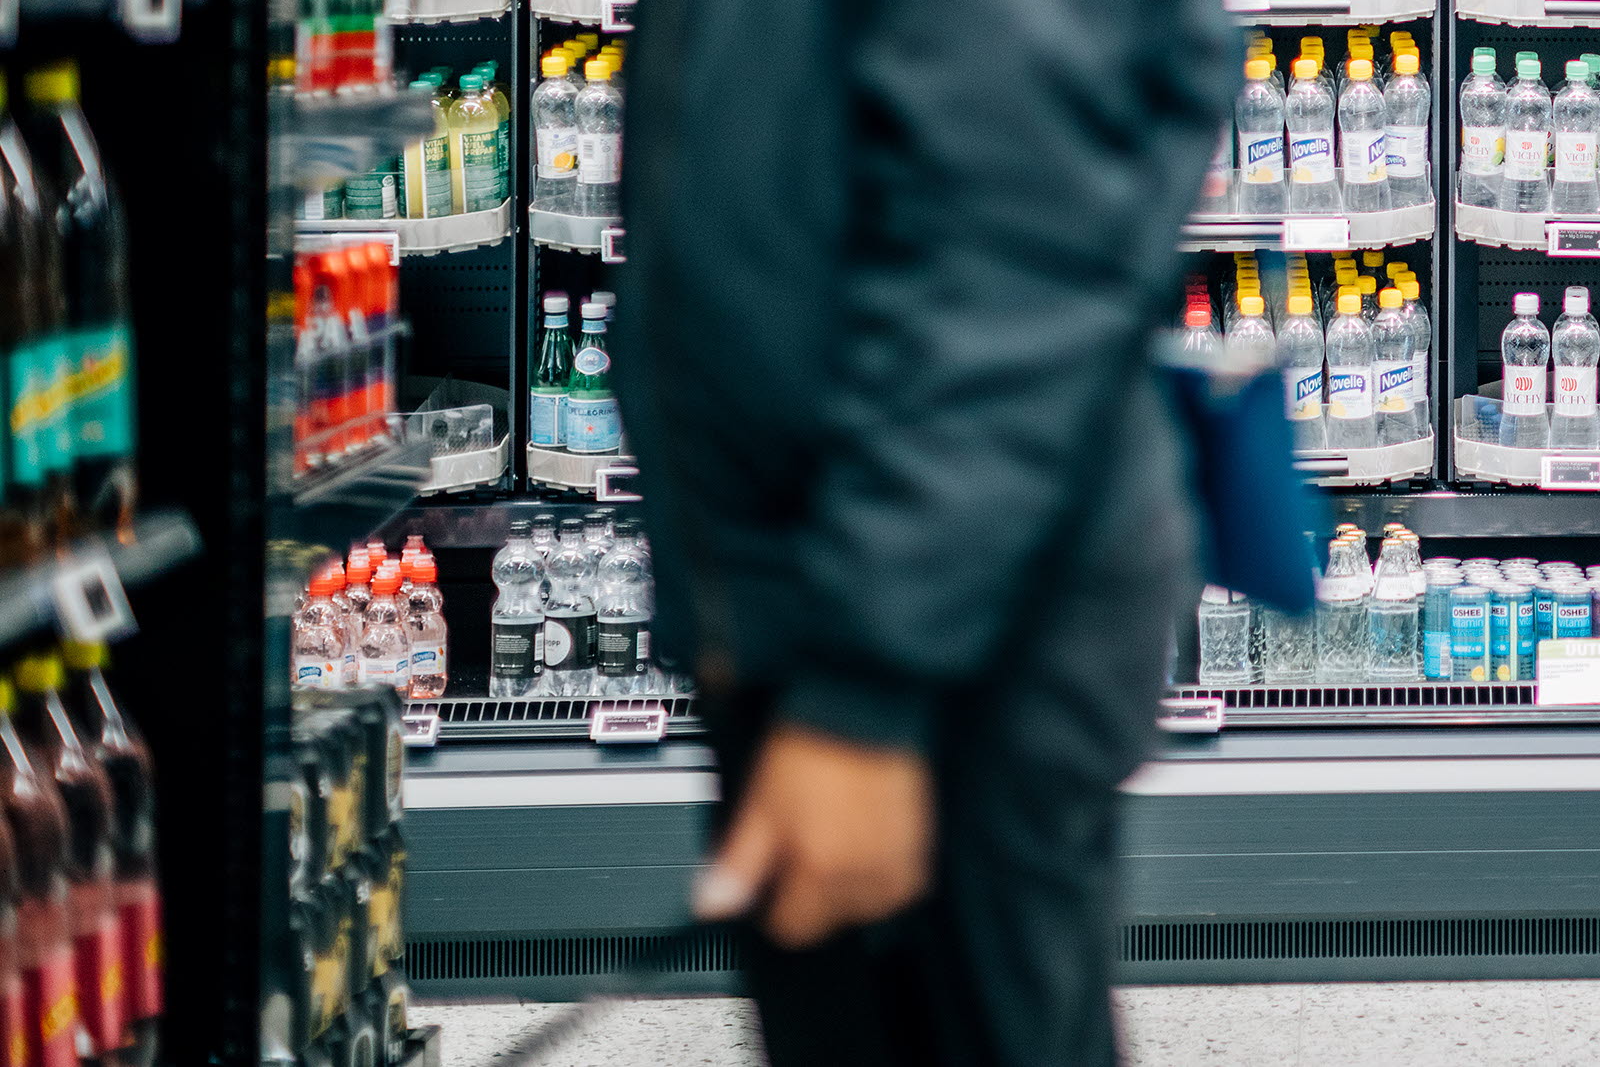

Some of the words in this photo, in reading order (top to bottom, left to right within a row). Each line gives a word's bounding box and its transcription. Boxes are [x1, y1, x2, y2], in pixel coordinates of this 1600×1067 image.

[1512, 151, 1542, 159] VICHY
[1506, 393, 1541, 404] VICHY
[1453, 609, 1481, 617] OSHEE
[1491, 606, 1505, 615] HEE
[1560, 608, 1588, 617] OSHEE
[1453, 618, 1483, 627] vitamin
[1558, 618, 1589, 627] vitamin
